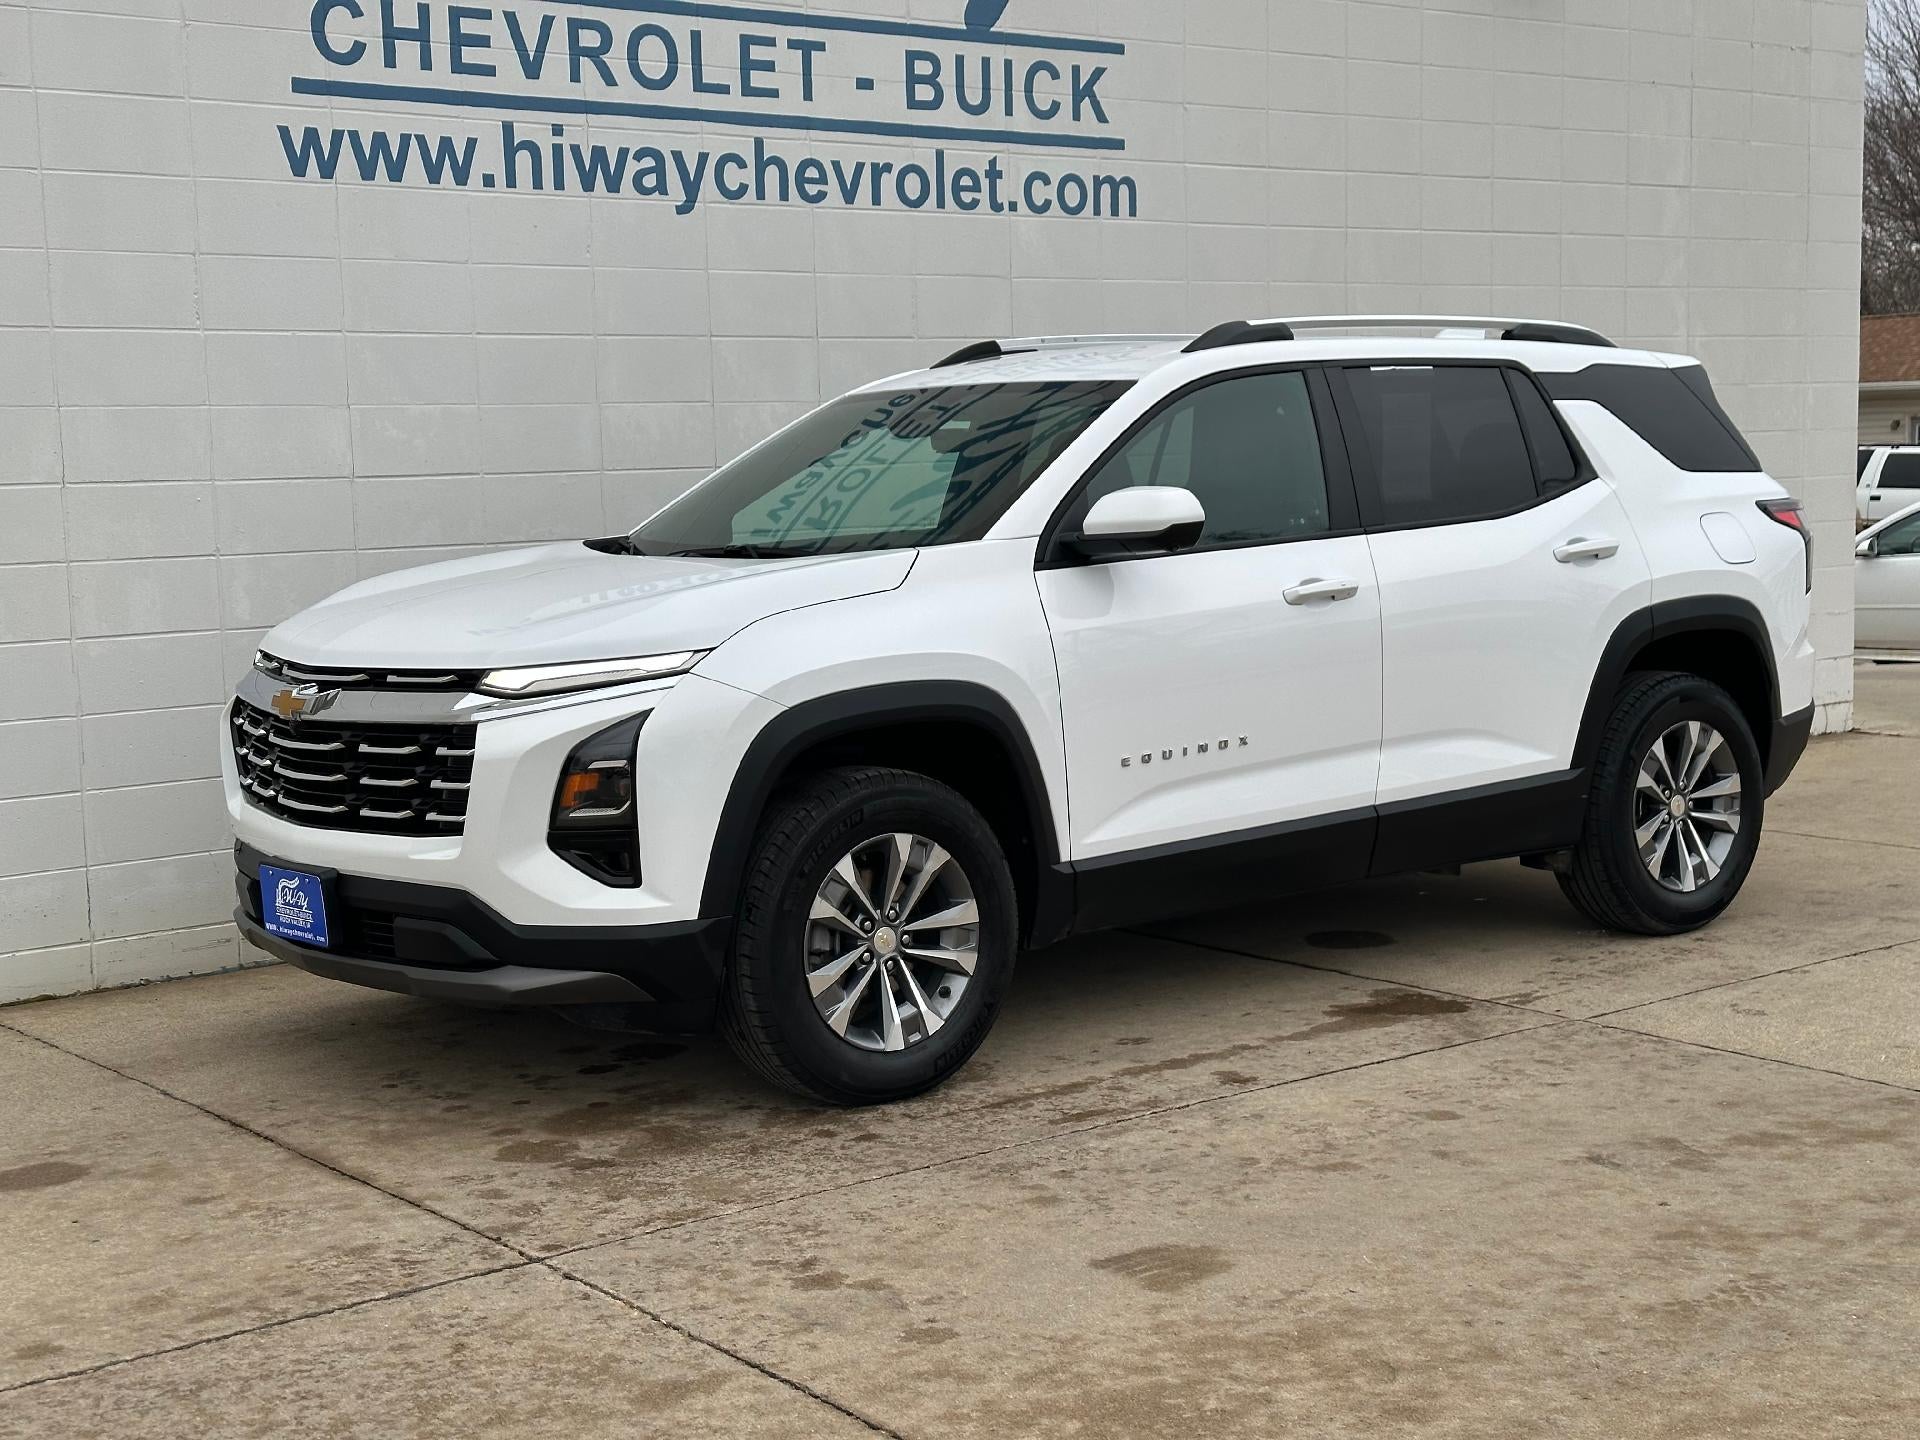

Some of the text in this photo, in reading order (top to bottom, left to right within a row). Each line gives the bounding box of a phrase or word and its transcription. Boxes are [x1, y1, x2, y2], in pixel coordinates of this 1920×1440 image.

[310, 0, 826, 102] CHEVROLET
[905, 49, 1110, 124] BUICK
[276, 120, 1138, 217] www.hiwaychevrolet.com
[1120, 735, 1249, 768] EQUINOX
